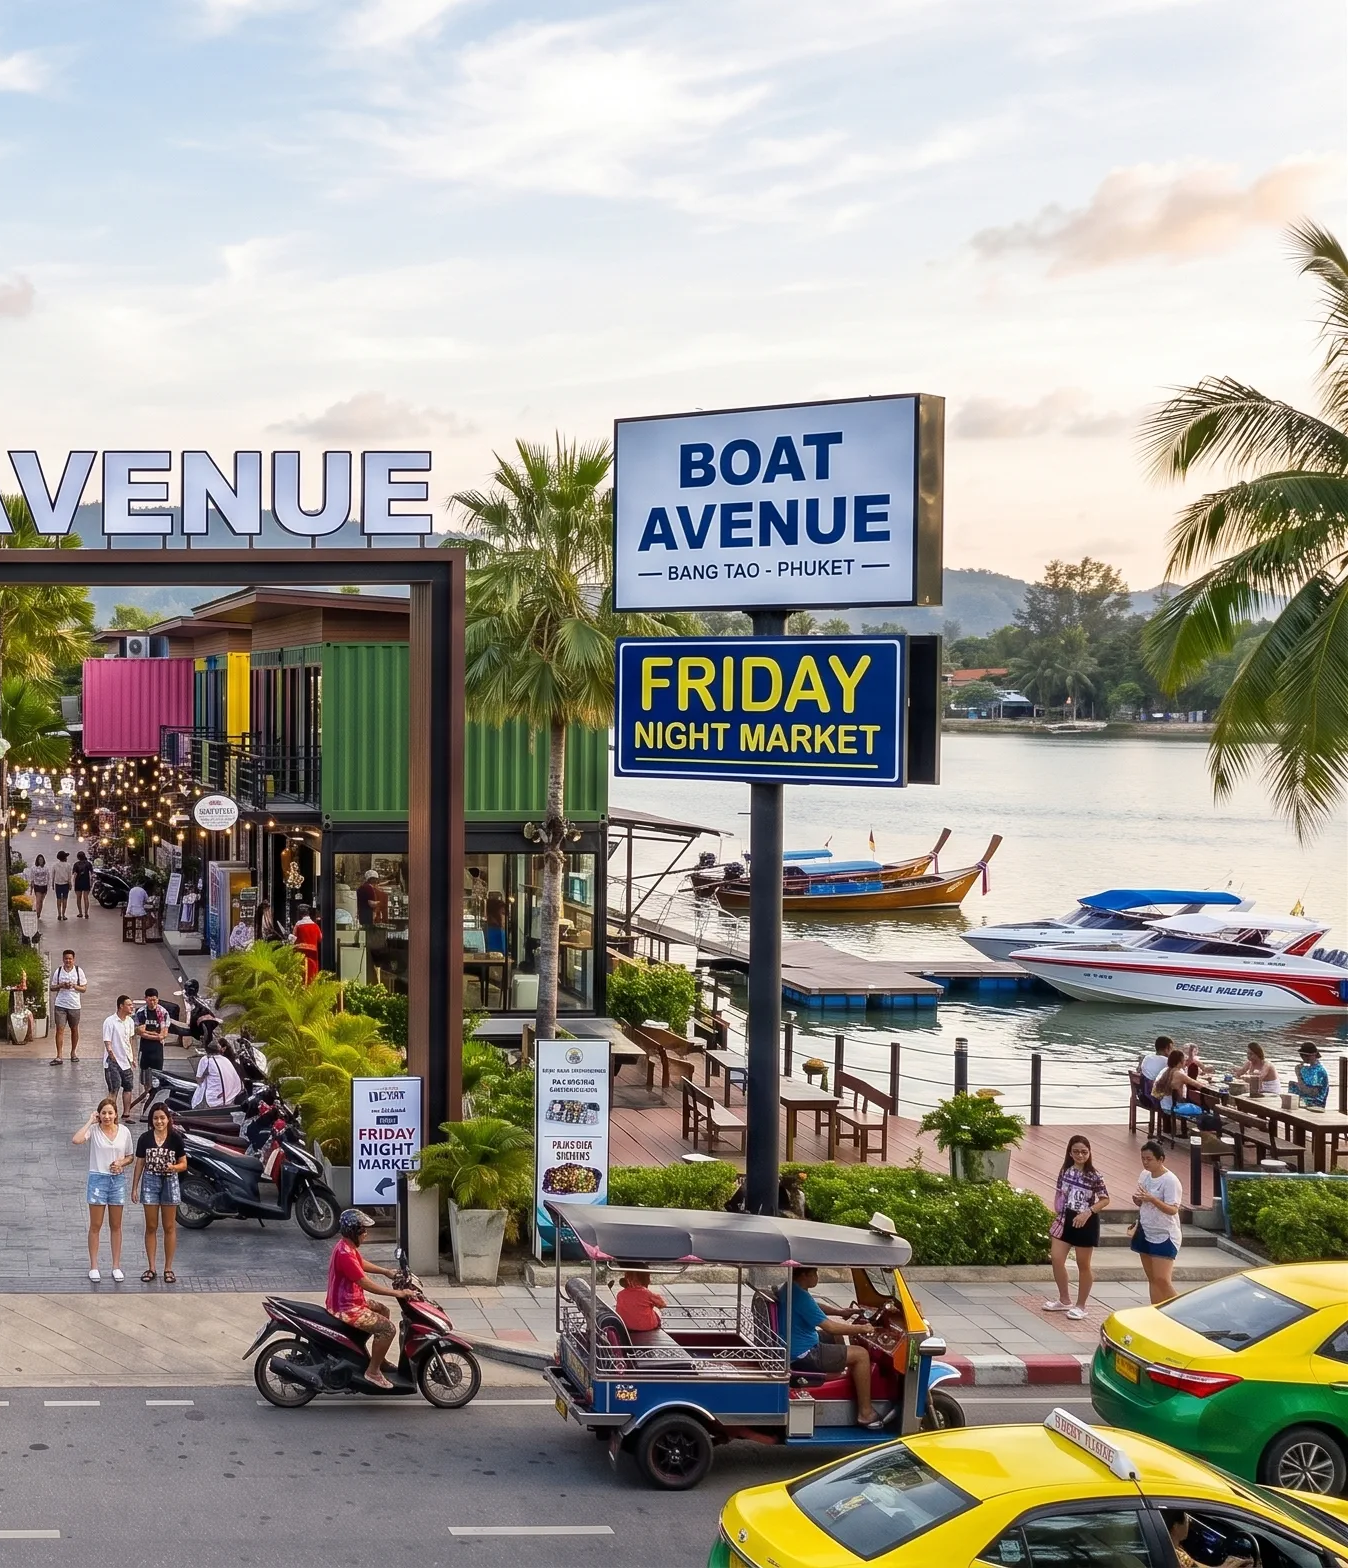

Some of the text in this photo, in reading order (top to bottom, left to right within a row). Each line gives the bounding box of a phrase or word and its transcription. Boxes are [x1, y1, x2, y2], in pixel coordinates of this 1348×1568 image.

[679, 431, 844, 489] BOAT
[637, 493, 891, 553] AVENUE
[668, 562, 719, 582] BANG
[724, 561, 760, 580] TAO
[778, 559, 856, 577] PHUKET
[641, 654, 872, 714] FRIDAY
[634, 721, 881, 755] NIGHT MARKET
[359, 1128, 416, 1140] FRIDAY
[360, 1142, 414, 1156] NIGHT
[358, 1159, 419, 1170] MARKET
